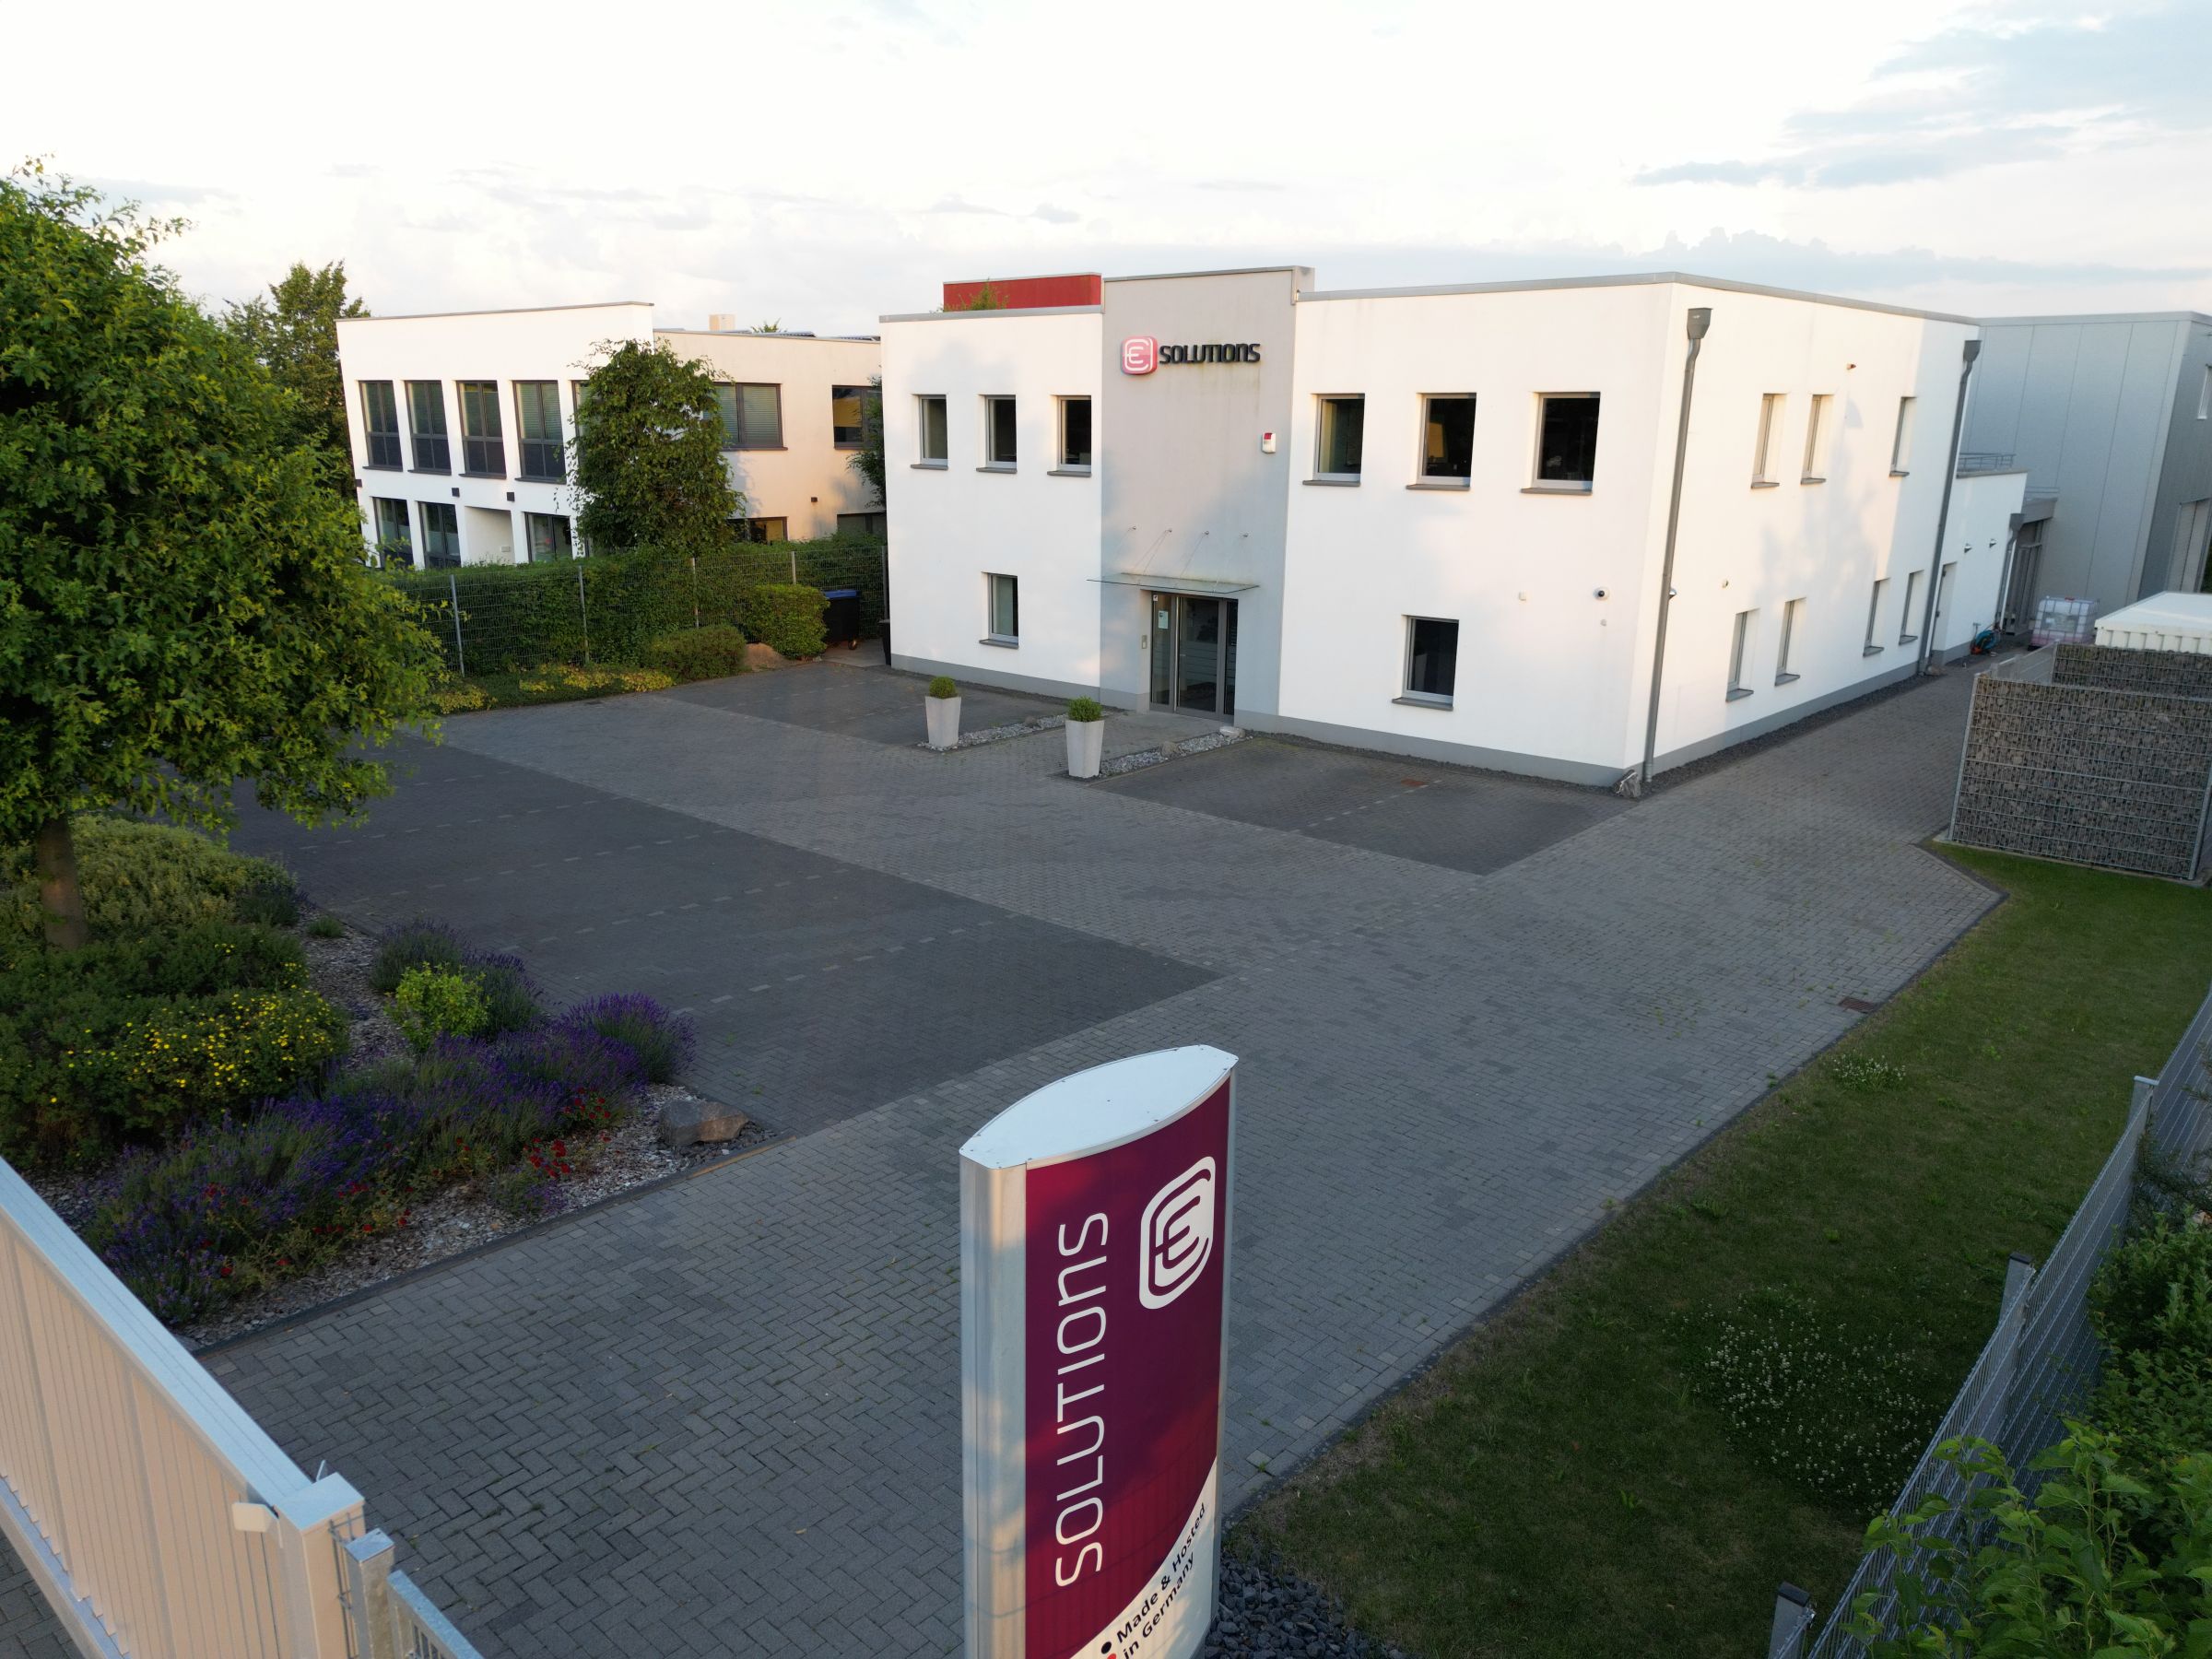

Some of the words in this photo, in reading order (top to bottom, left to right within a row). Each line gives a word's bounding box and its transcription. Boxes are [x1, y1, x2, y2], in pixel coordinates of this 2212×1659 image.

[1116, 1592, 1159, 1643] Made
[1160, 1575, 1171, 1591] &
[1171, 1502, 1206, 1572] Hosted
[1123, 1641, 1139, 1659] in
[1142, 1551, 1194, 1638] Germany
